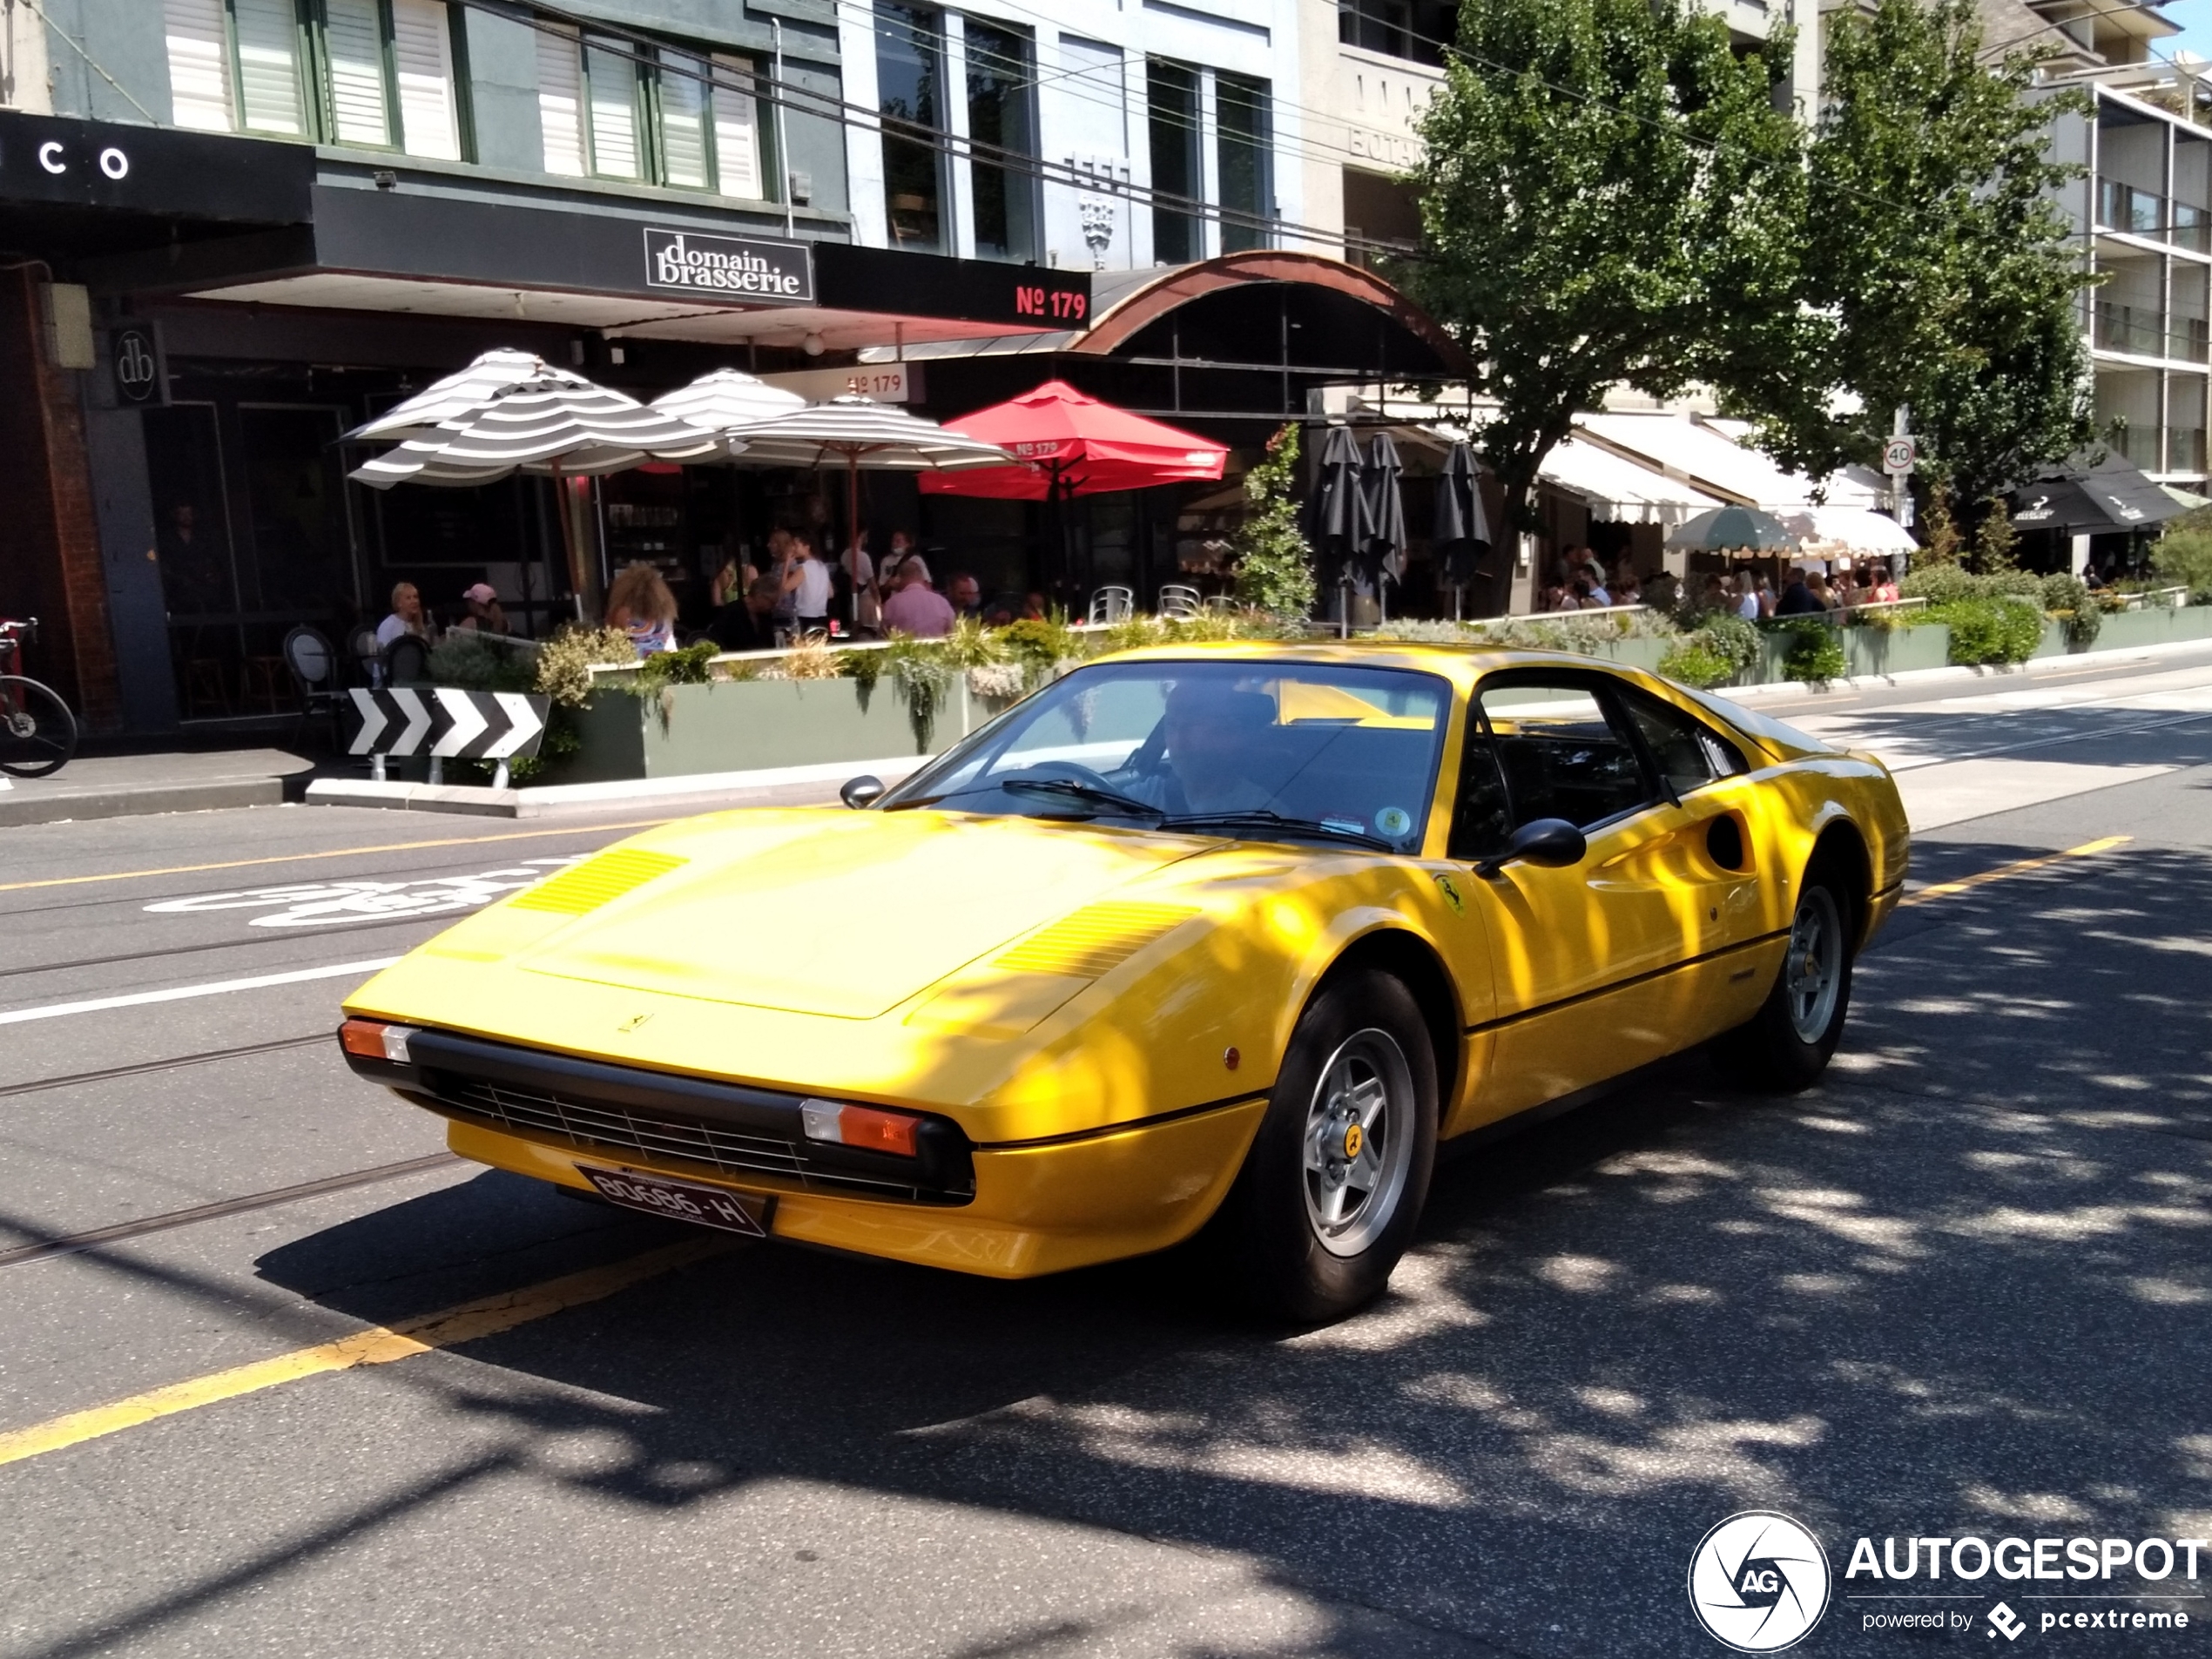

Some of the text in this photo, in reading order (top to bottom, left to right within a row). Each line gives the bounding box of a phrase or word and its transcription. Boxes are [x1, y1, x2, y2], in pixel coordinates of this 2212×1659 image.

[0, 141, 129, 180] CO
[664, 235, 769, 273] domain
[656, 253, 799, 294] brasserie
[1050, 291, 1086, 320] 179
[118, 338, 154, 384] db
[873, 374, 901, 393] 179
[1035, 442, 1058, 455] 179
[1889, 448, 1910, 462] 40
